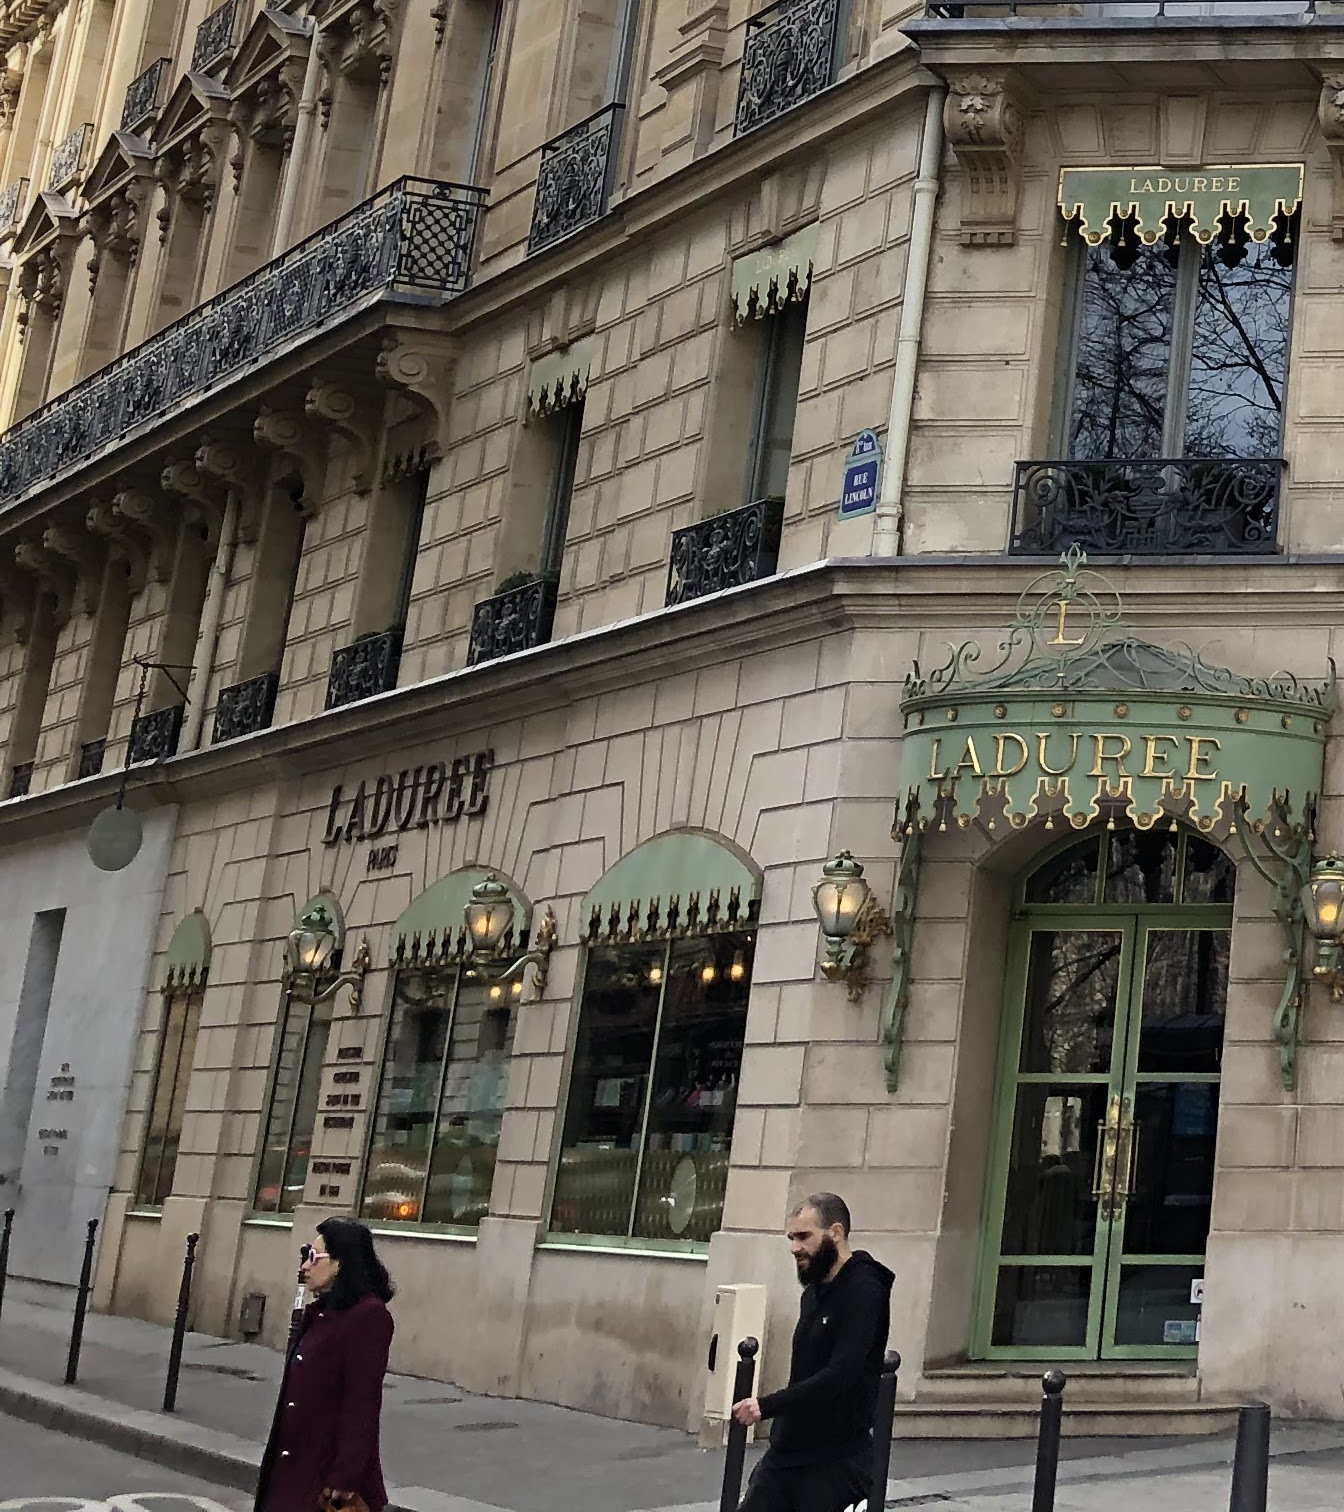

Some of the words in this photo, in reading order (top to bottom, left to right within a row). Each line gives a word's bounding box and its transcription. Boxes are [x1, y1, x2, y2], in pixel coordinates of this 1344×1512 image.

[1129, 177, 1241, 193] LADUREE
[853, 472, 868, 486] RUE
[845, 487, 873, 505] LINCOLN
[928, 732, 1222, 780] LADUREE
